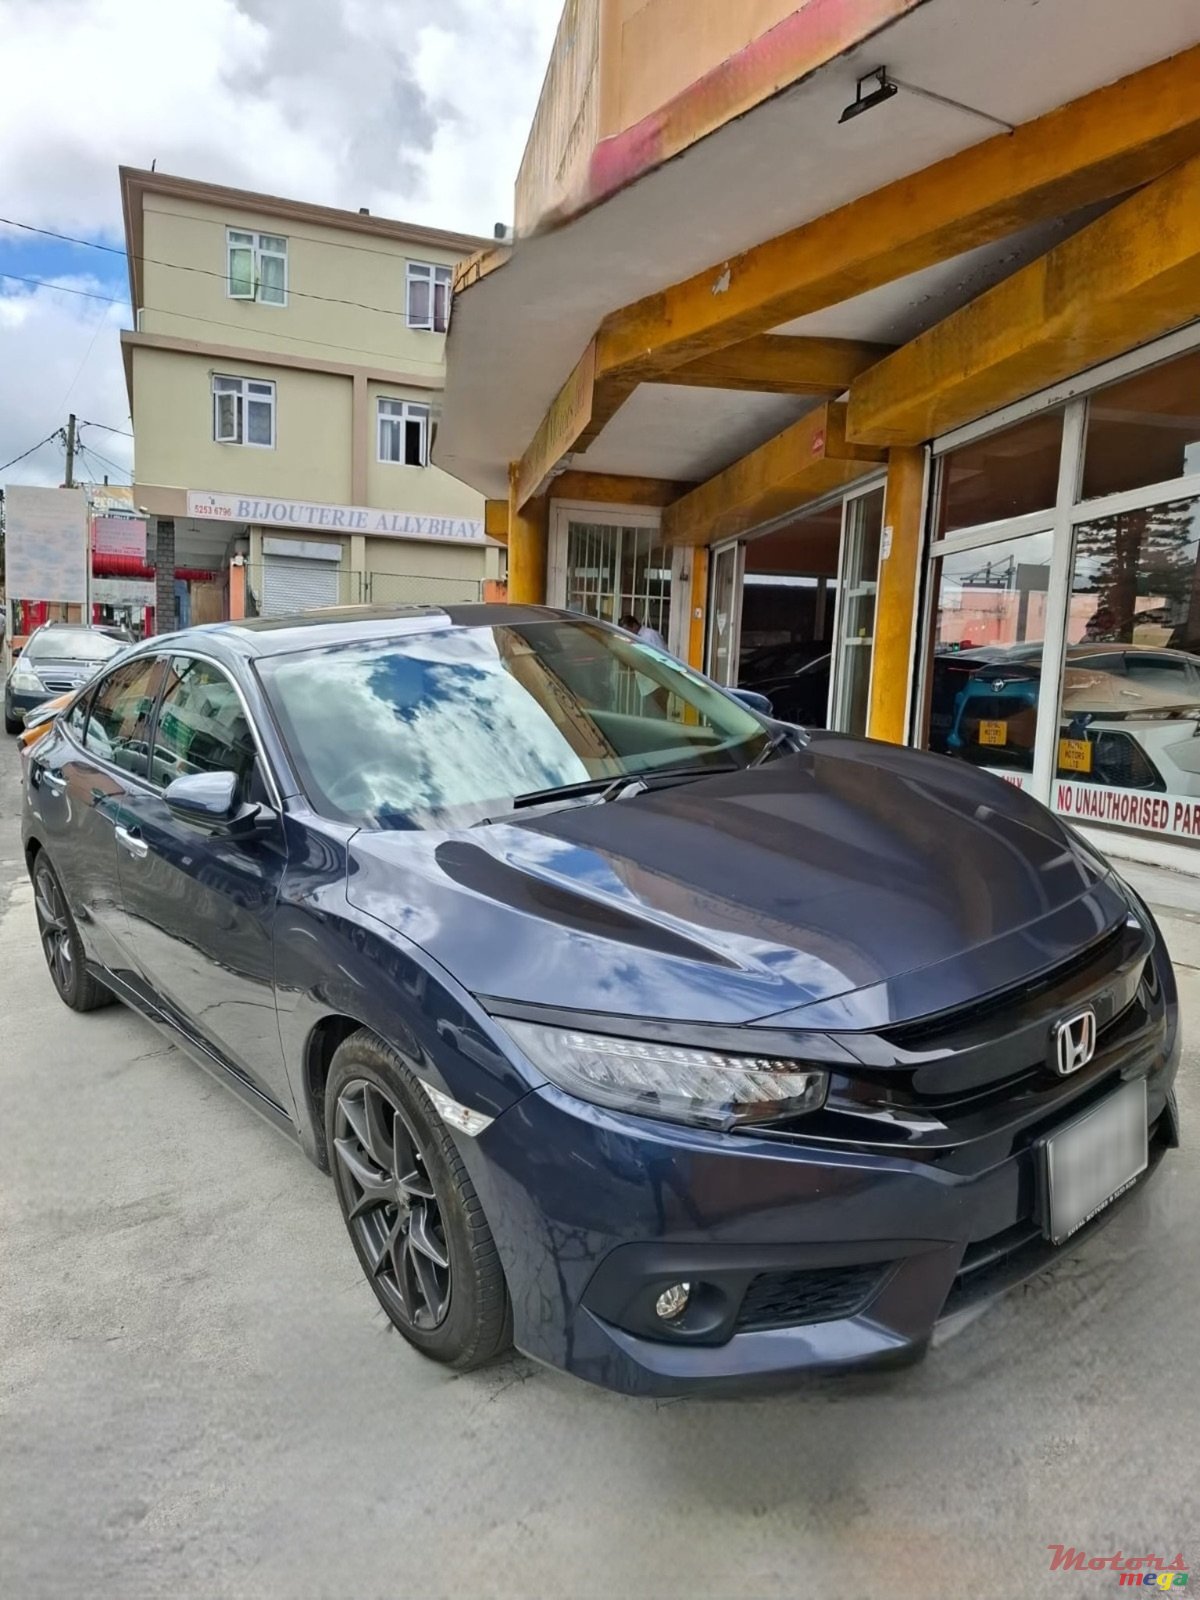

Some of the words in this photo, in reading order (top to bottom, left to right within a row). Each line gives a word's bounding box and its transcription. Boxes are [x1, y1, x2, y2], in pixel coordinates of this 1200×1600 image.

[194, 504, 212, 514] 5253
[237, 500, 369, 529] BIJOUTERIE
[374, 513, 481, 538] ALLYBHAY
[1057, 785, 1073, 811] NO
[1075, 789, 1169, 830] UNAUTHORISED
[1173, 802, 1200, 835] PAR
